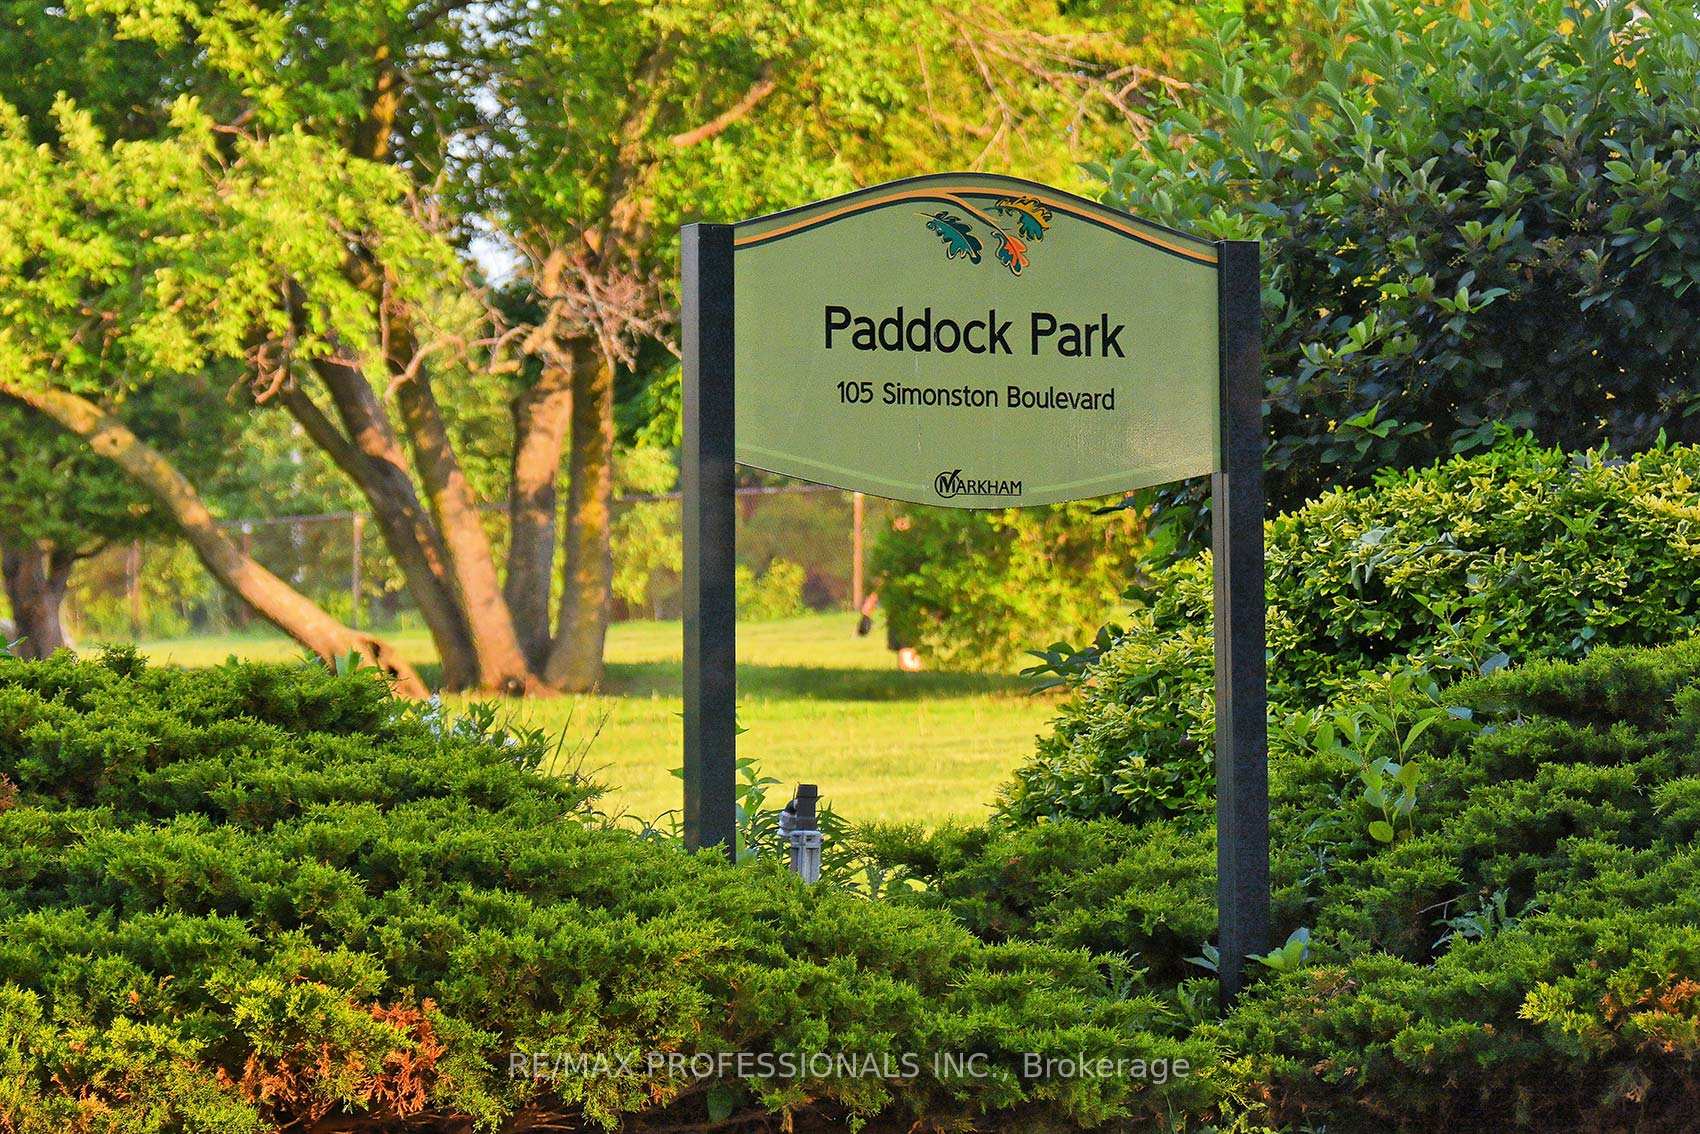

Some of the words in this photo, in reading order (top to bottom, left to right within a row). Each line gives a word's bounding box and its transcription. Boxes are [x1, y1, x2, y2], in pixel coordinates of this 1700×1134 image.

[824, 305, 1013, 355] Paddock
[1031, 312, 1126, 358] Park
[836, 381, 874, 404] 105
[882, 382, 999, 408] Simonston
[1007, 386, 1115, 411] Boulevard
[934, 469, 1022, 498] MARKHAM
